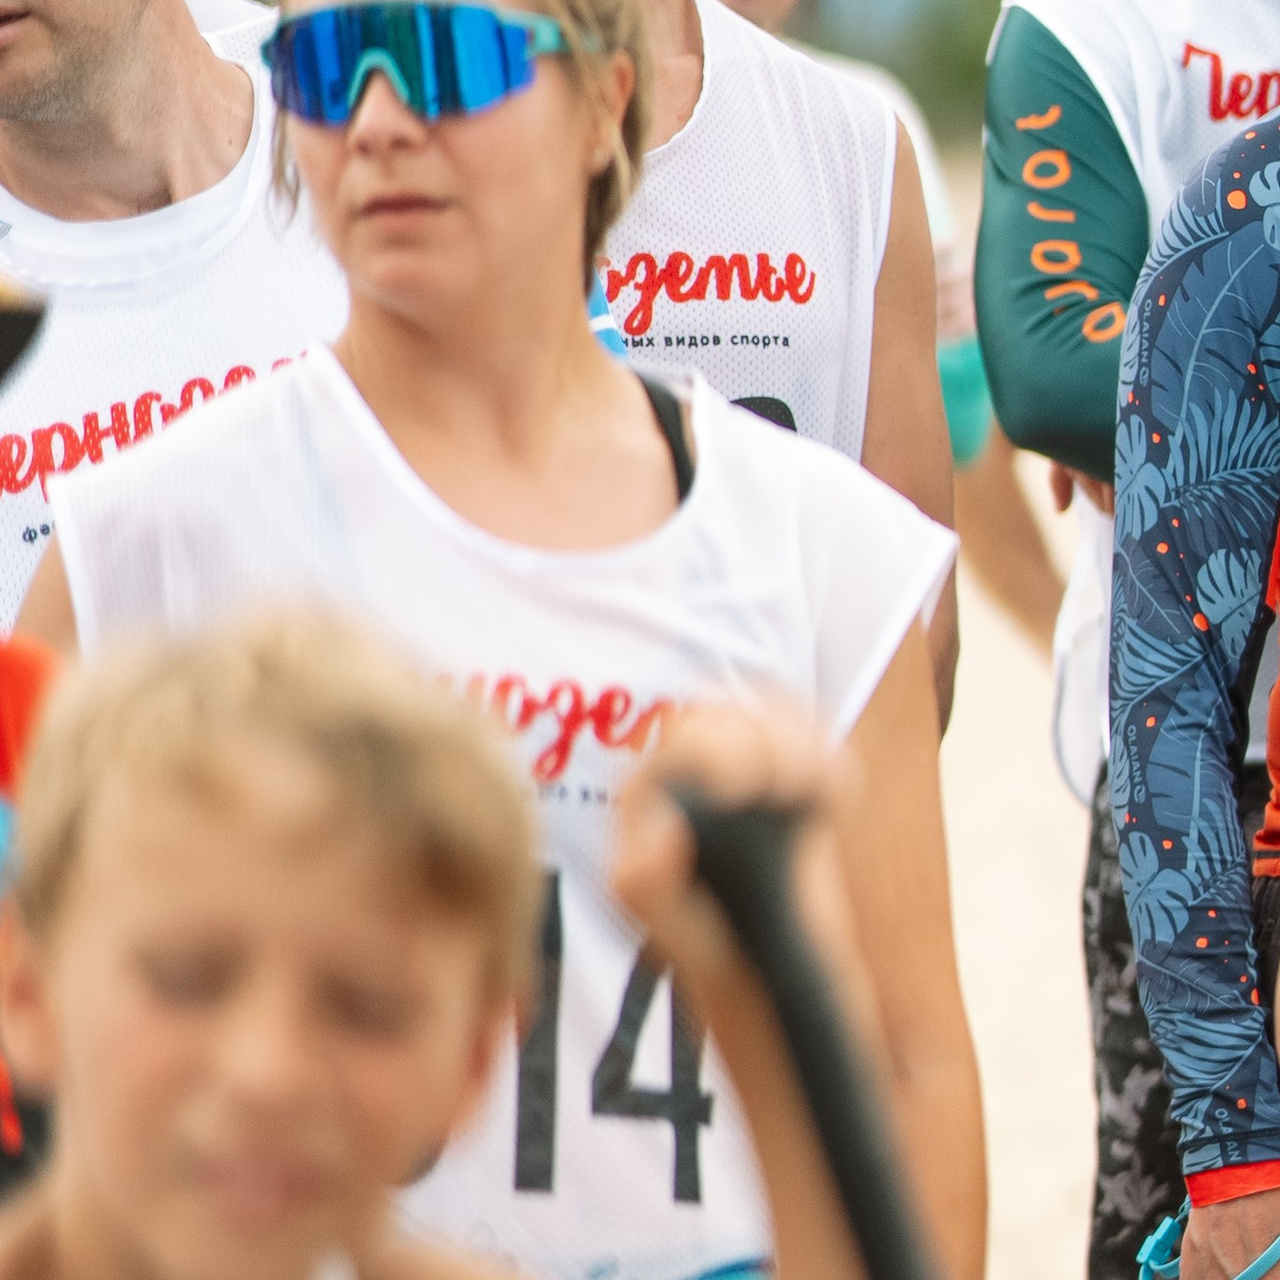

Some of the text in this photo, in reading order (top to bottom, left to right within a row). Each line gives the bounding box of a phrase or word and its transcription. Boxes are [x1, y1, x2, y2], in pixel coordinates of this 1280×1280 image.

[665, 334, 721, 349] видов
[731, 334, 791, 349] спорта
[1141, 299, 1152, 363] OLAIAN
[1127, 725, 1143, 785] OLAIAN
[513, 868, 714, 1204] 14
[1215, 1108, 1242, 1161] OLAAN
